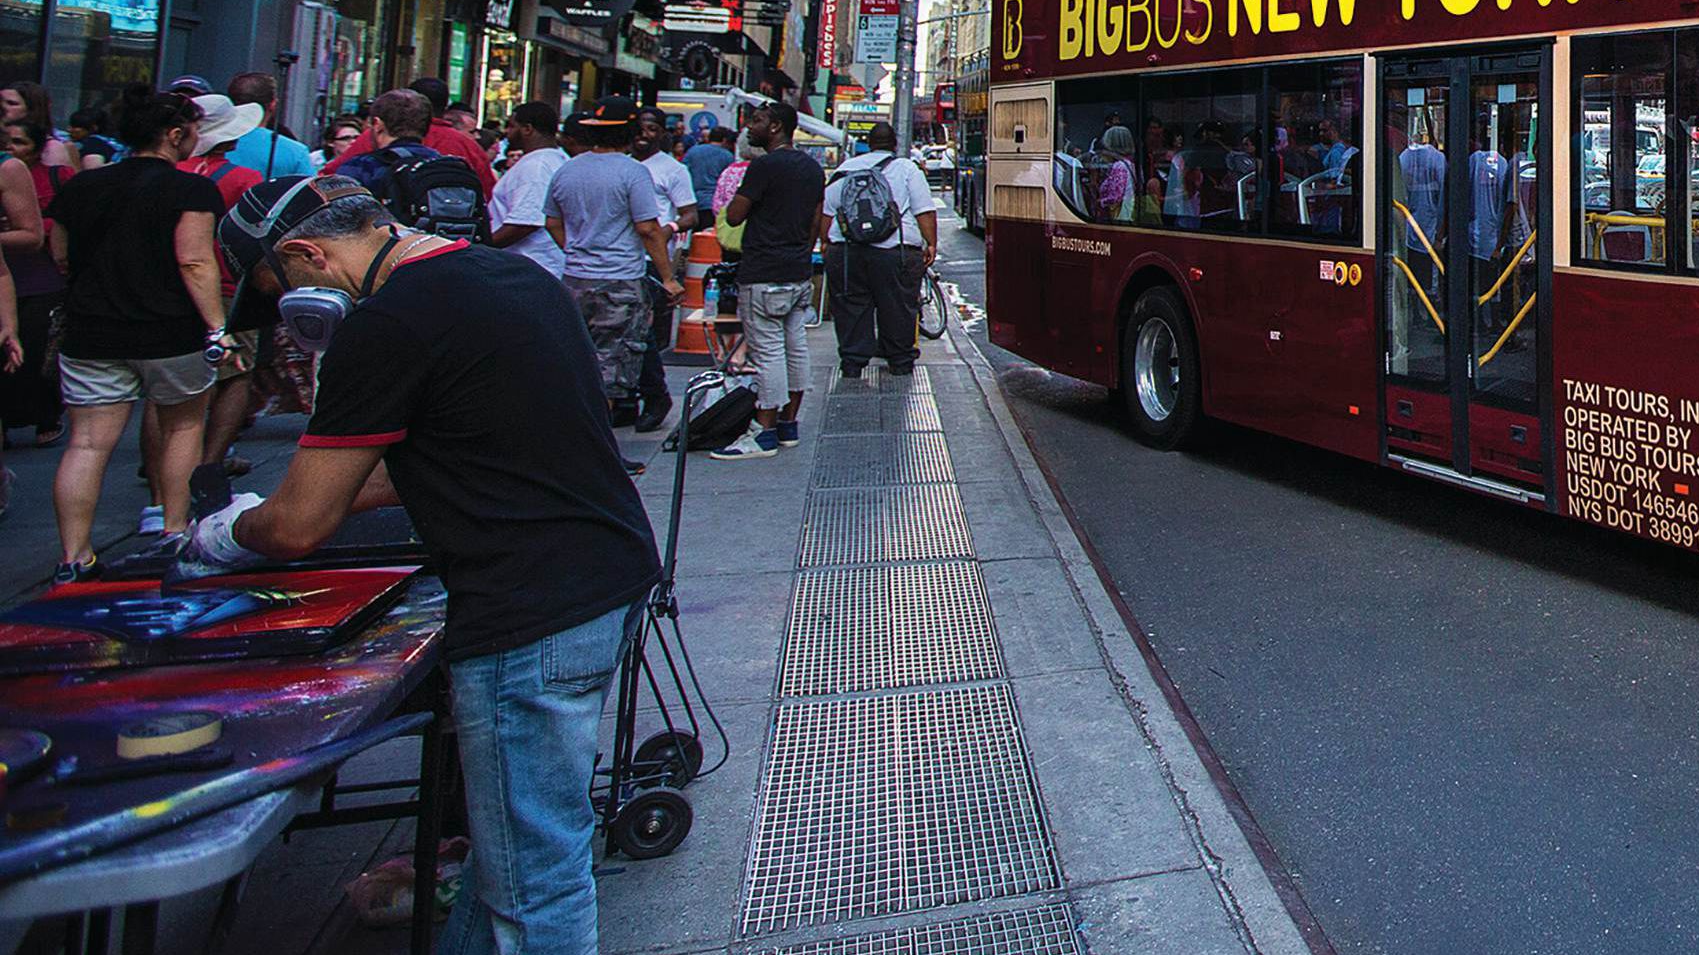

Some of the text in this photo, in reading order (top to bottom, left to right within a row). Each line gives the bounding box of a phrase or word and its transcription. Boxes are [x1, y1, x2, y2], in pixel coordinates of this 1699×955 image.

[566, 7, 611, 17] WAFFLES
[1563, 379, 1600, 405] TAXI
[1604, 386, 1675, 423] TOURS,
[1564, 406, 1691, 450] OPERATED BY
[1565, 428, 1596, 453] BIG
[1600, 436, 1637, 462] BUS
[1566, 450, 1662, 493] NEW YORK
[1567, 472, 1627, 507] USDOT
[1568, 495, 1602, 522] NYS
[1607, 505, 1644, 534] DOT
